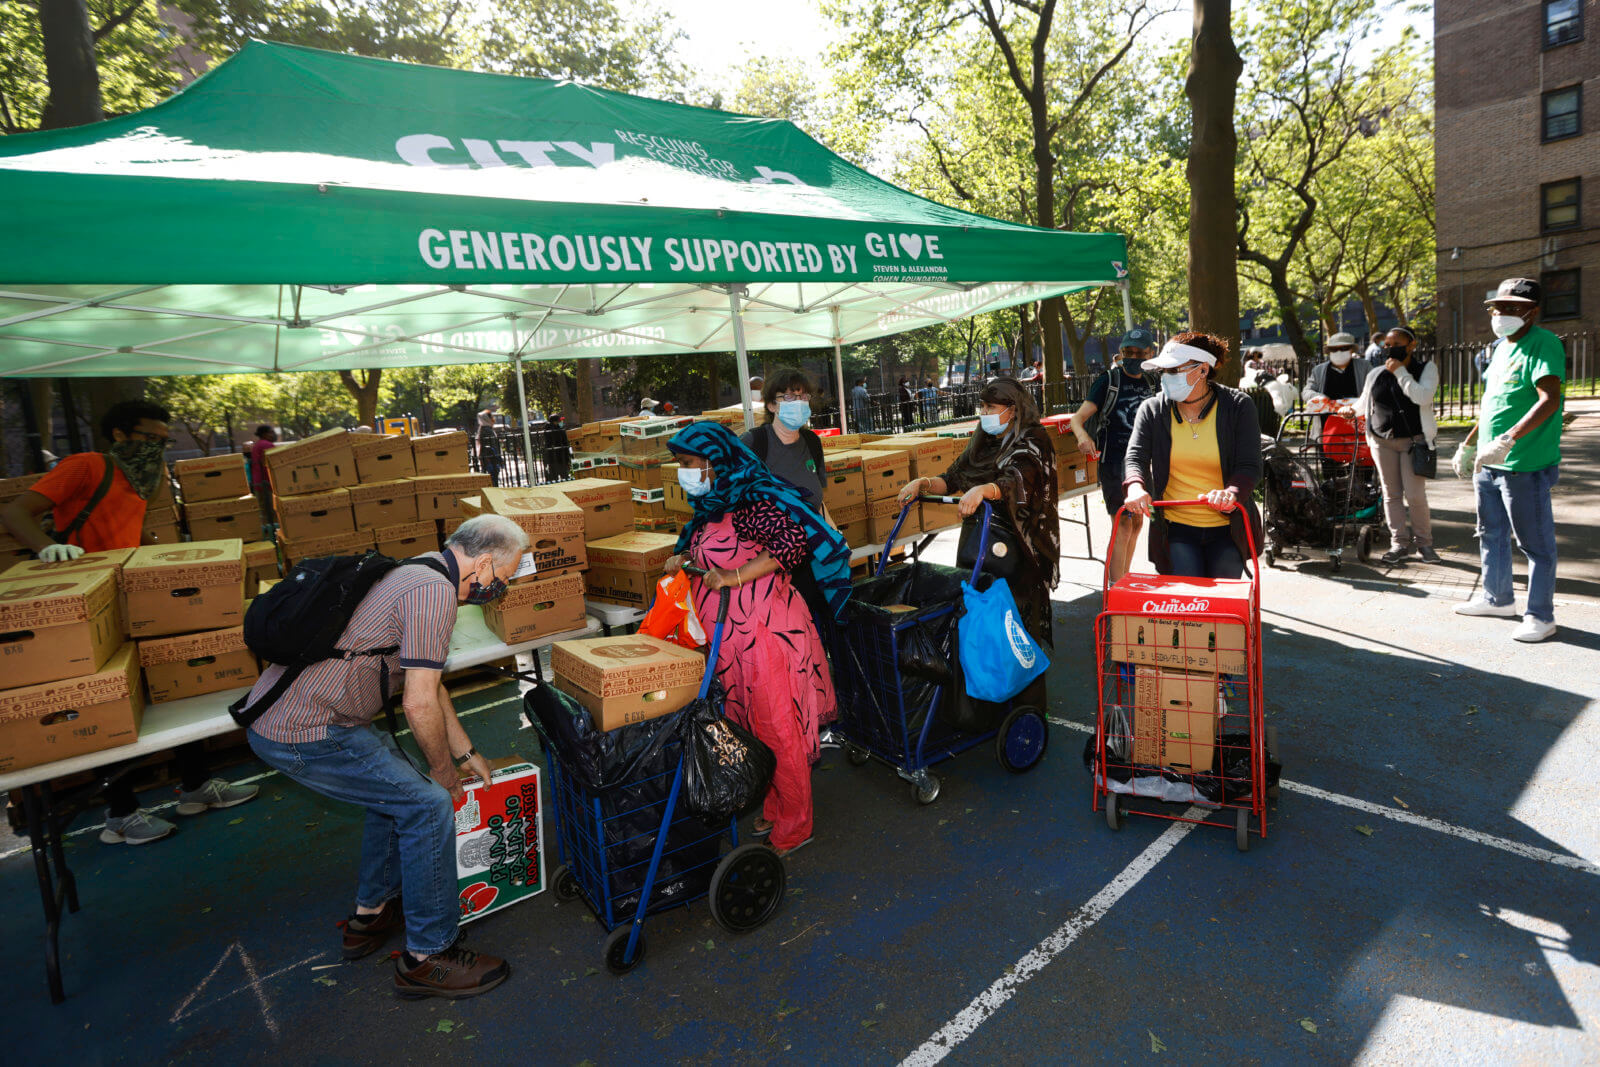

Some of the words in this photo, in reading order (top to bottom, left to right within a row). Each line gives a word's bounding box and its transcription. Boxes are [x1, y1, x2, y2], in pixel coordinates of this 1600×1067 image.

[615, 129, 708, 157] RESCUING
[645, 147, 700, 168] FOOD
[700, 155, 741, 174] FOR
[418, 228, 652, 271] GENEROUSLY
[665, 239, 822, 274] SUPPORTED
[828, 244, 858, 275] BY
[873, 264, 899, 273] STEVEN
[901, 265, 907, 273] &
[908, 265, 948, 273] ALEXANDRA
[536, 555, 577, 570] matoes
[162, 574, 194, 583] LIPMAN
[44, 597, 85, 607] LIPMAN
[1142, 597, 1210, 612] Crimson
[13, 618, 50, 629] VELVET
[223, 631, 243, 640] LIPM
[602, 670, 630, 679] VELVET
[677, 660, 704, 668] LIPMAN
[88, 675, 128, 688] LIPMAN
[634, 674, 663, 683] LIPMAN
[611, 686, 641, 696] LIPMAN
[655, 680, 681, 689] VELVET
[25, 695, 67, 709] LIPMAN
[0, 711, 37, 723] PMAN
[58, 698, 95, 711] VELVET
[521, 783, 538, 845] TOMATOES
[505, 795, 524, 885] ITALIANO
[488, 815, 507, 883] PRIMO
[525, 843, 538, 886] ROMA
